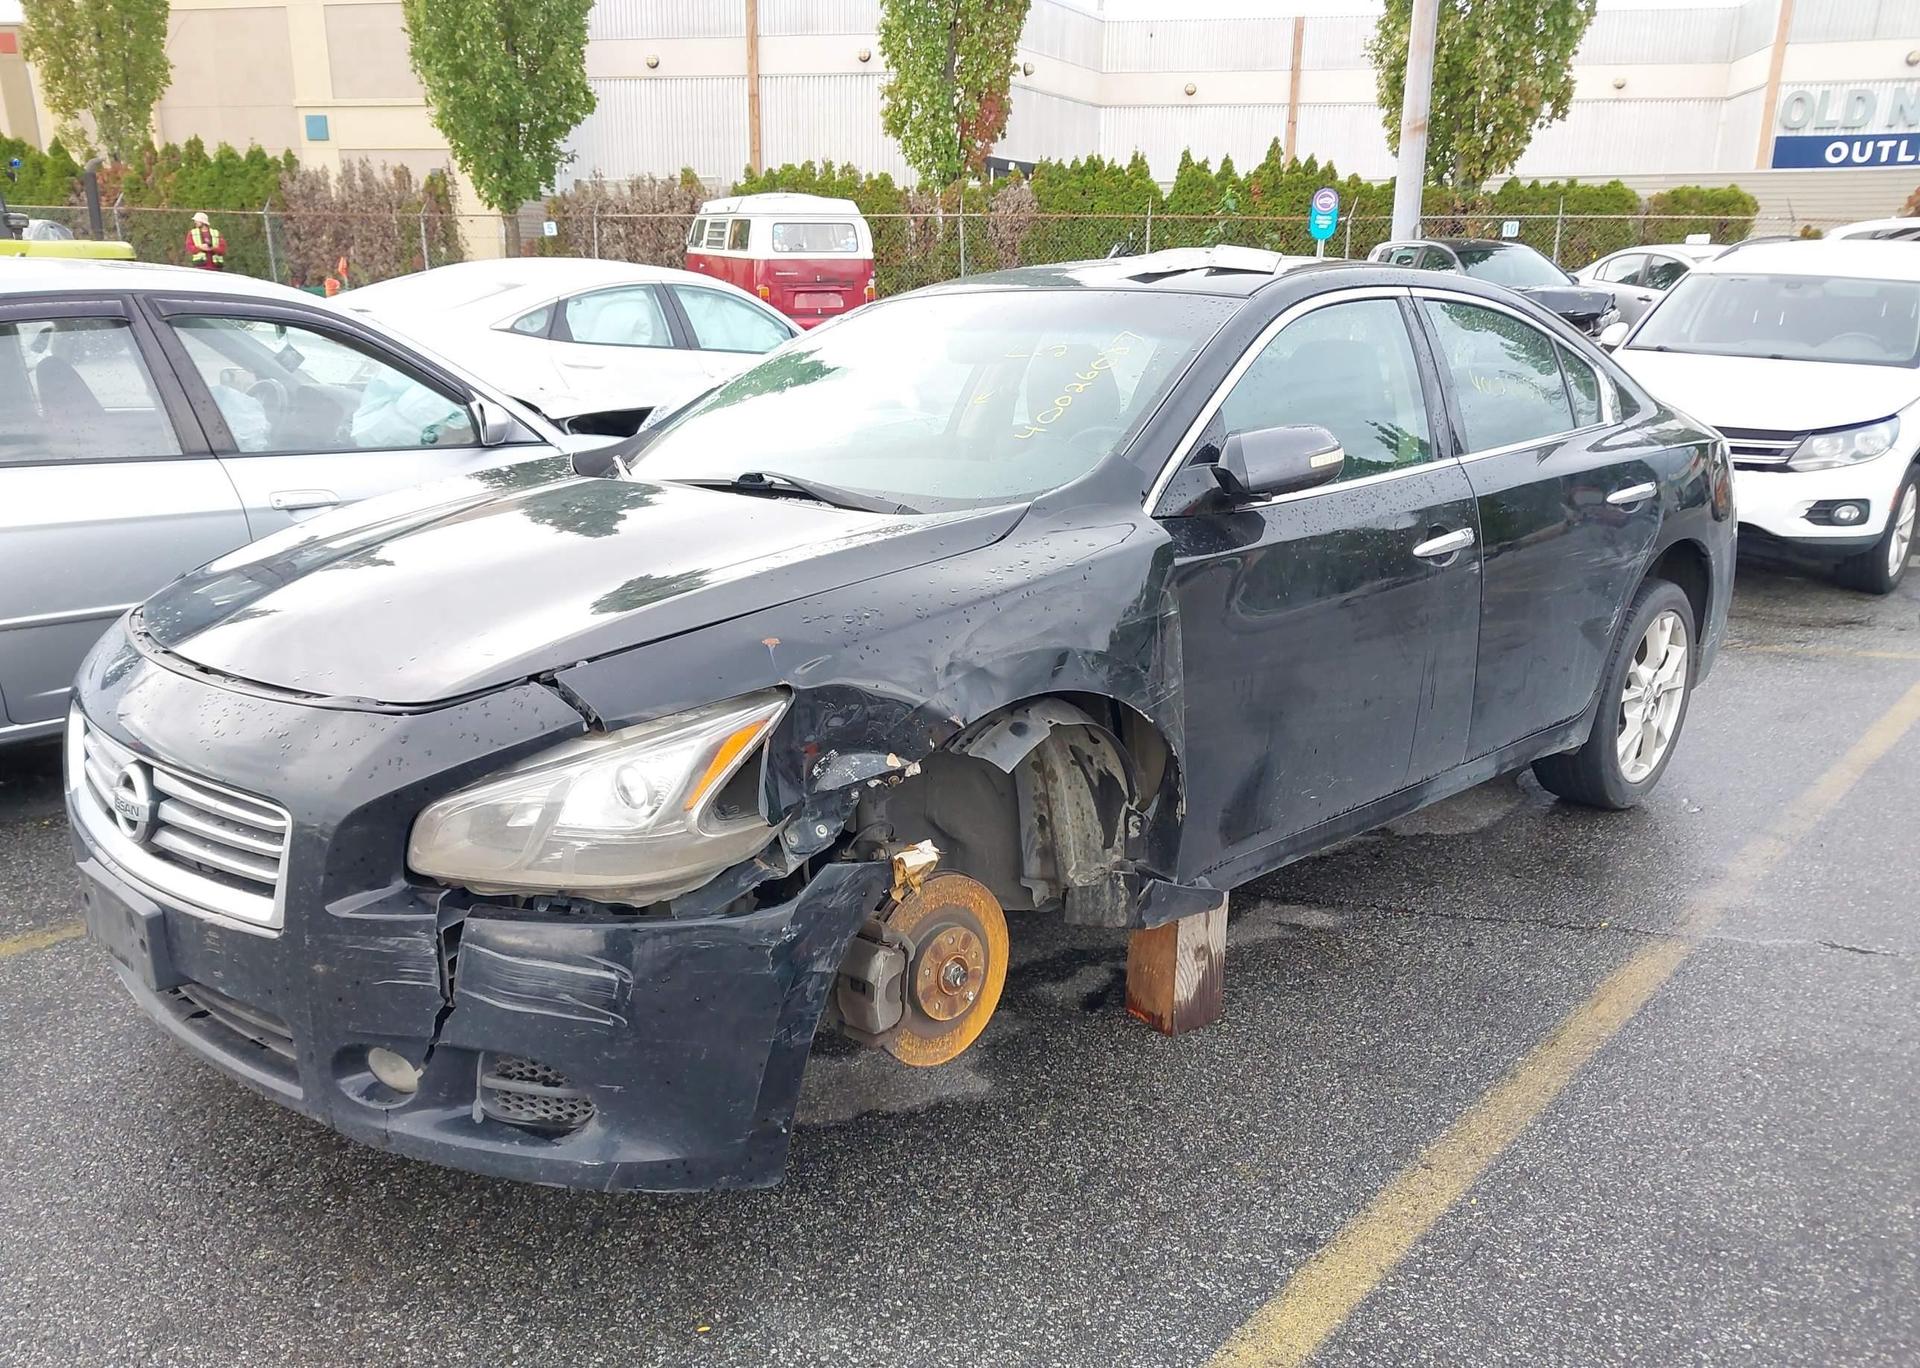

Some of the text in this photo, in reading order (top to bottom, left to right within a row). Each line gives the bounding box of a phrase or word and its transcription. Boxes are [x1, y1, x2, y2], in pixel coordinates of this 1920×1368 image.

[1780, 88, 1878, 130] OLD
[1824, 139, 1920, 164] OUTL
[1504, 223, 1517, 236] 10
